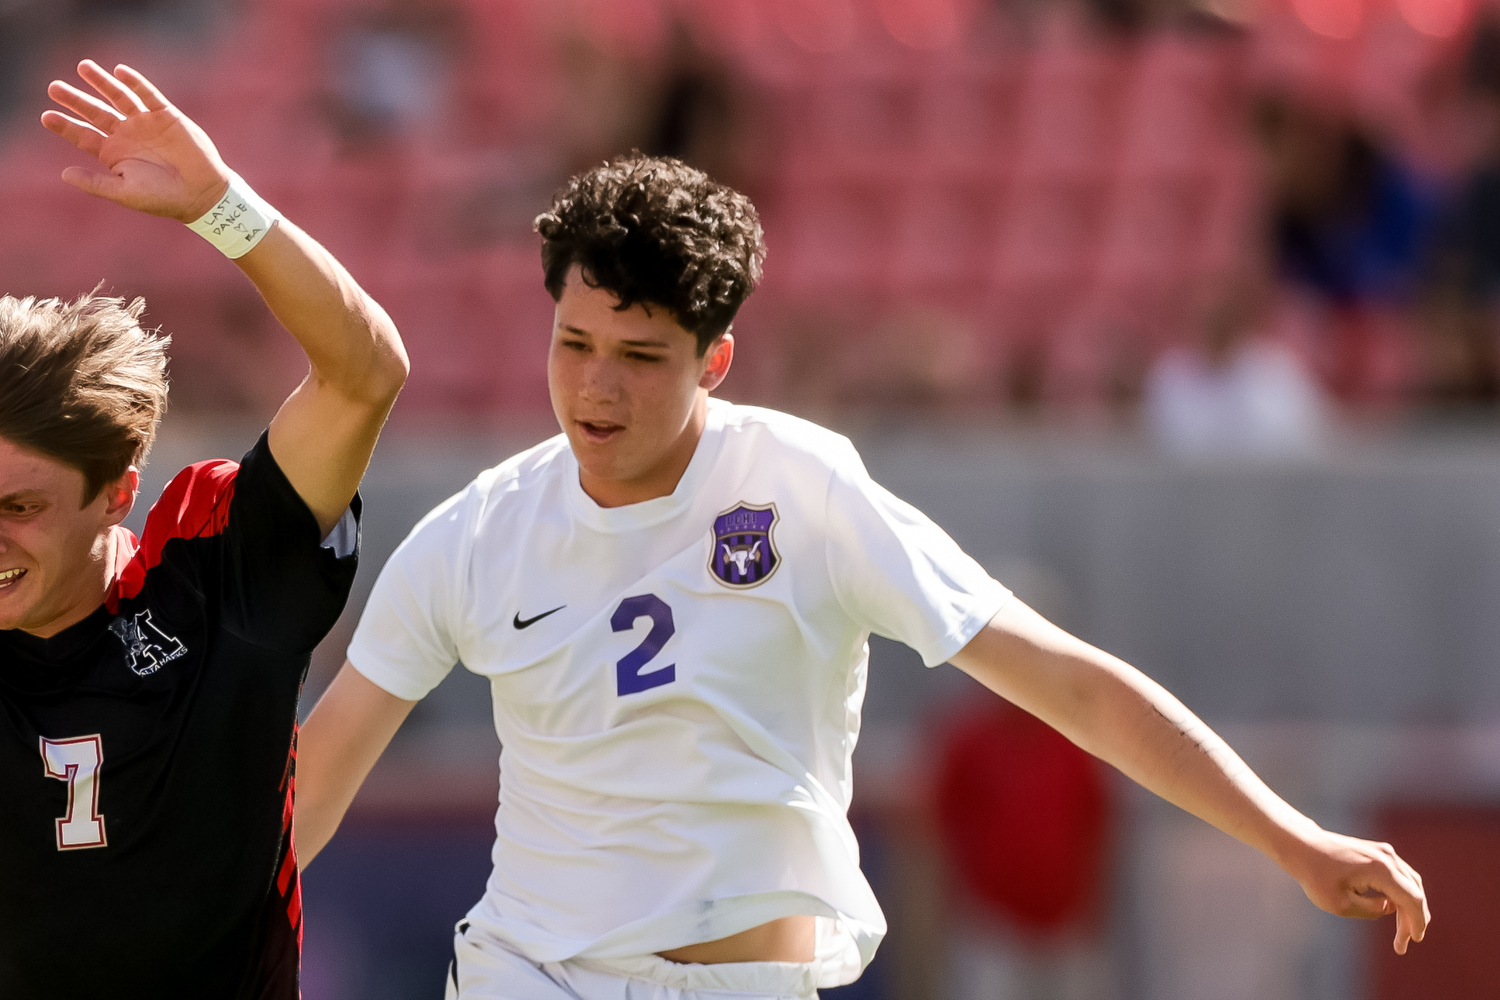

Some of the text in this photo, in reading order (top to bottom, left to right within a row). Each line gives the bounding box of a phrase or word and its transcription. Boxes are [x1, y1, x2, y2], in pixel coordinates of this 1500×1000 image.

[204, 196, 231, 226] LAST
[212, 203, 248, 235] DANCE
[609, 593, 676, 697] 2
[39, 733, 108, 851] 7
